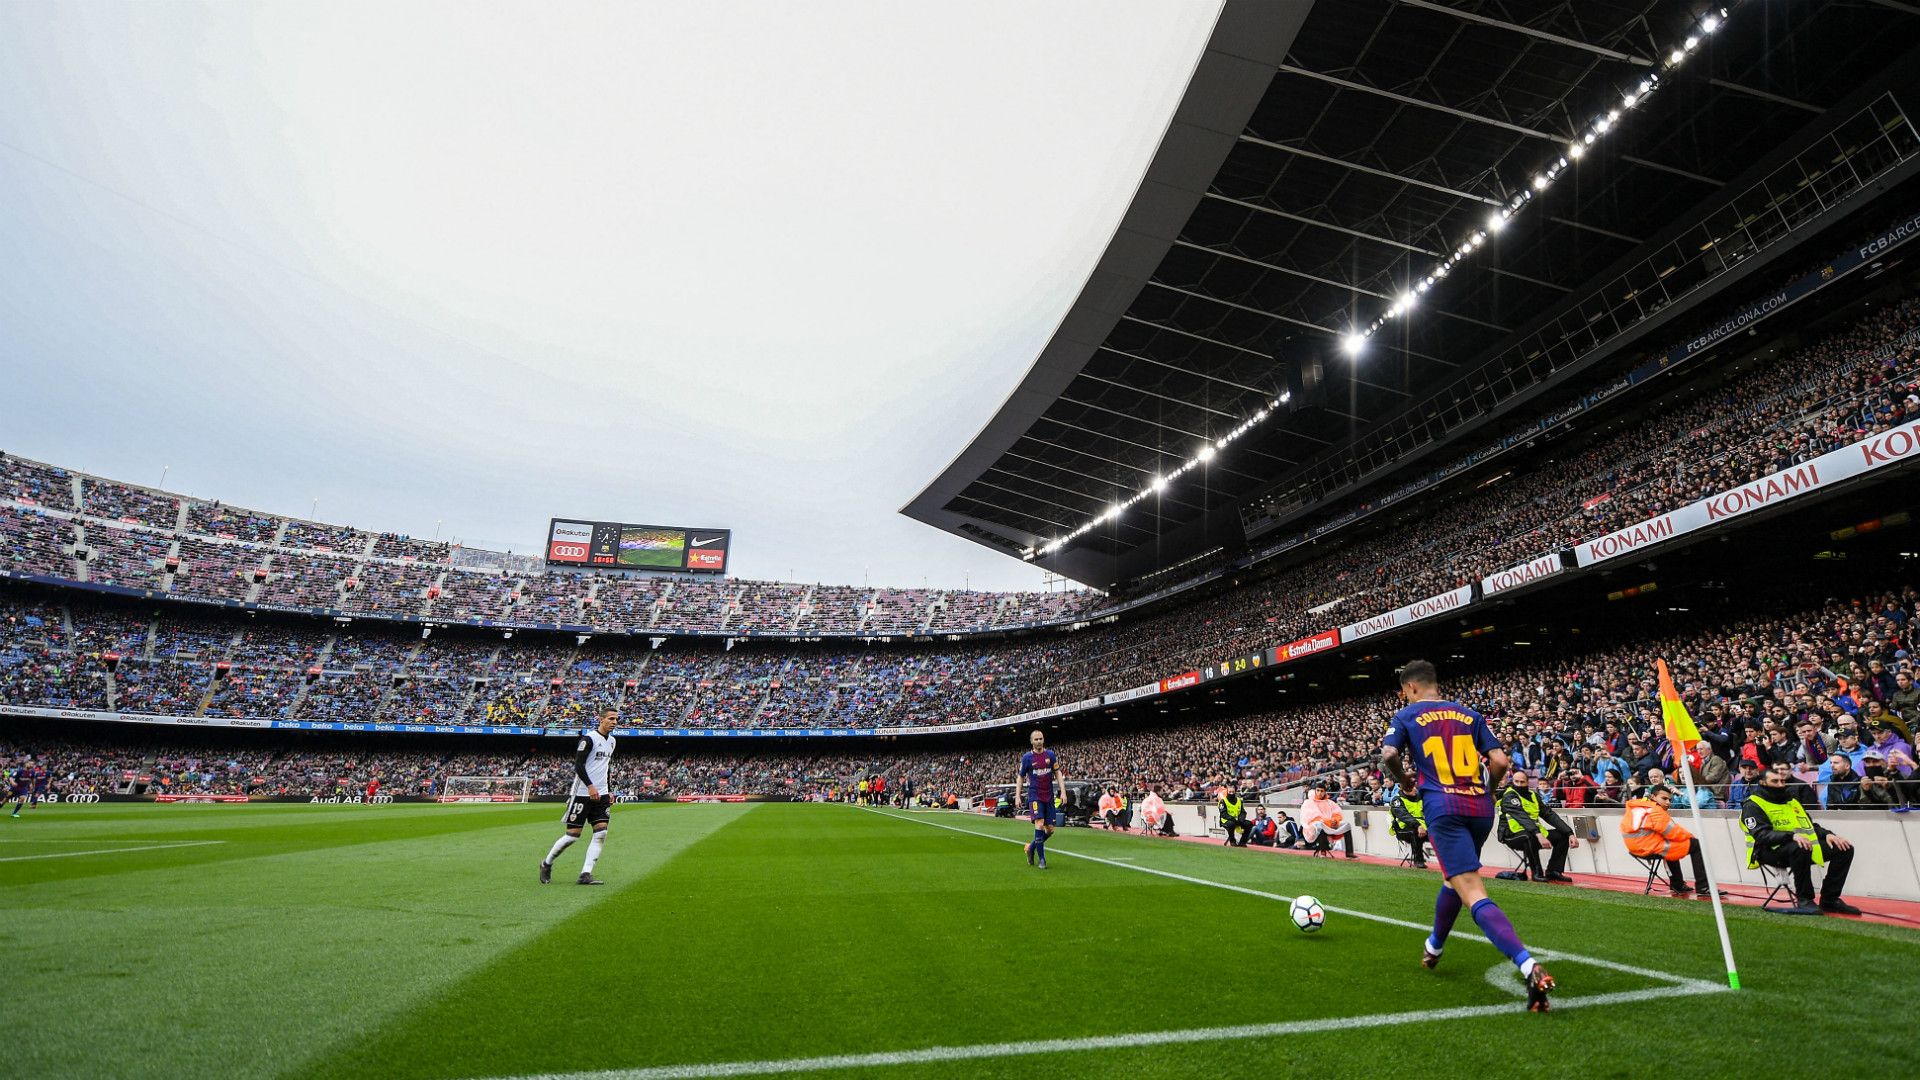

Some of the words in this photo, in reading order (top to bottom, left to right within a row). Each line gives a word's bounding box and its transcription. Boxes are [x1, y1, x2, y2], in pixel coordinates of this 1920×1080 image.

[1687, 292, 1788, 353] FCBARCELONA.COM
[1705, 464, 1820, 520] KONAMI
[561, 529, 590, 537] Rakuten
[1589, 516, 1674, 560] KONAMI
[1492, 557, 1557, 592] KONAMI
[1409, 592, 1459, 619] KONAMI
[1353, 614, 1395, 637] KONAMI
[1288, 641, 1313, 658] Estrella
[1311, 636, 1333, 651] Damm
[1234, 658, 1246, 672] 2-0
[1135, 685, 1155, 697] KONAMI
[1415, 710, 1474, 727] COUTINHO
[1422, 734, 1482, 785] 14
[37, 794, 58, 803] A8
[310, 796, 340, 804] Audi
[342, 796, 361, 804] A8
[572, 802, 584, 815] 19
